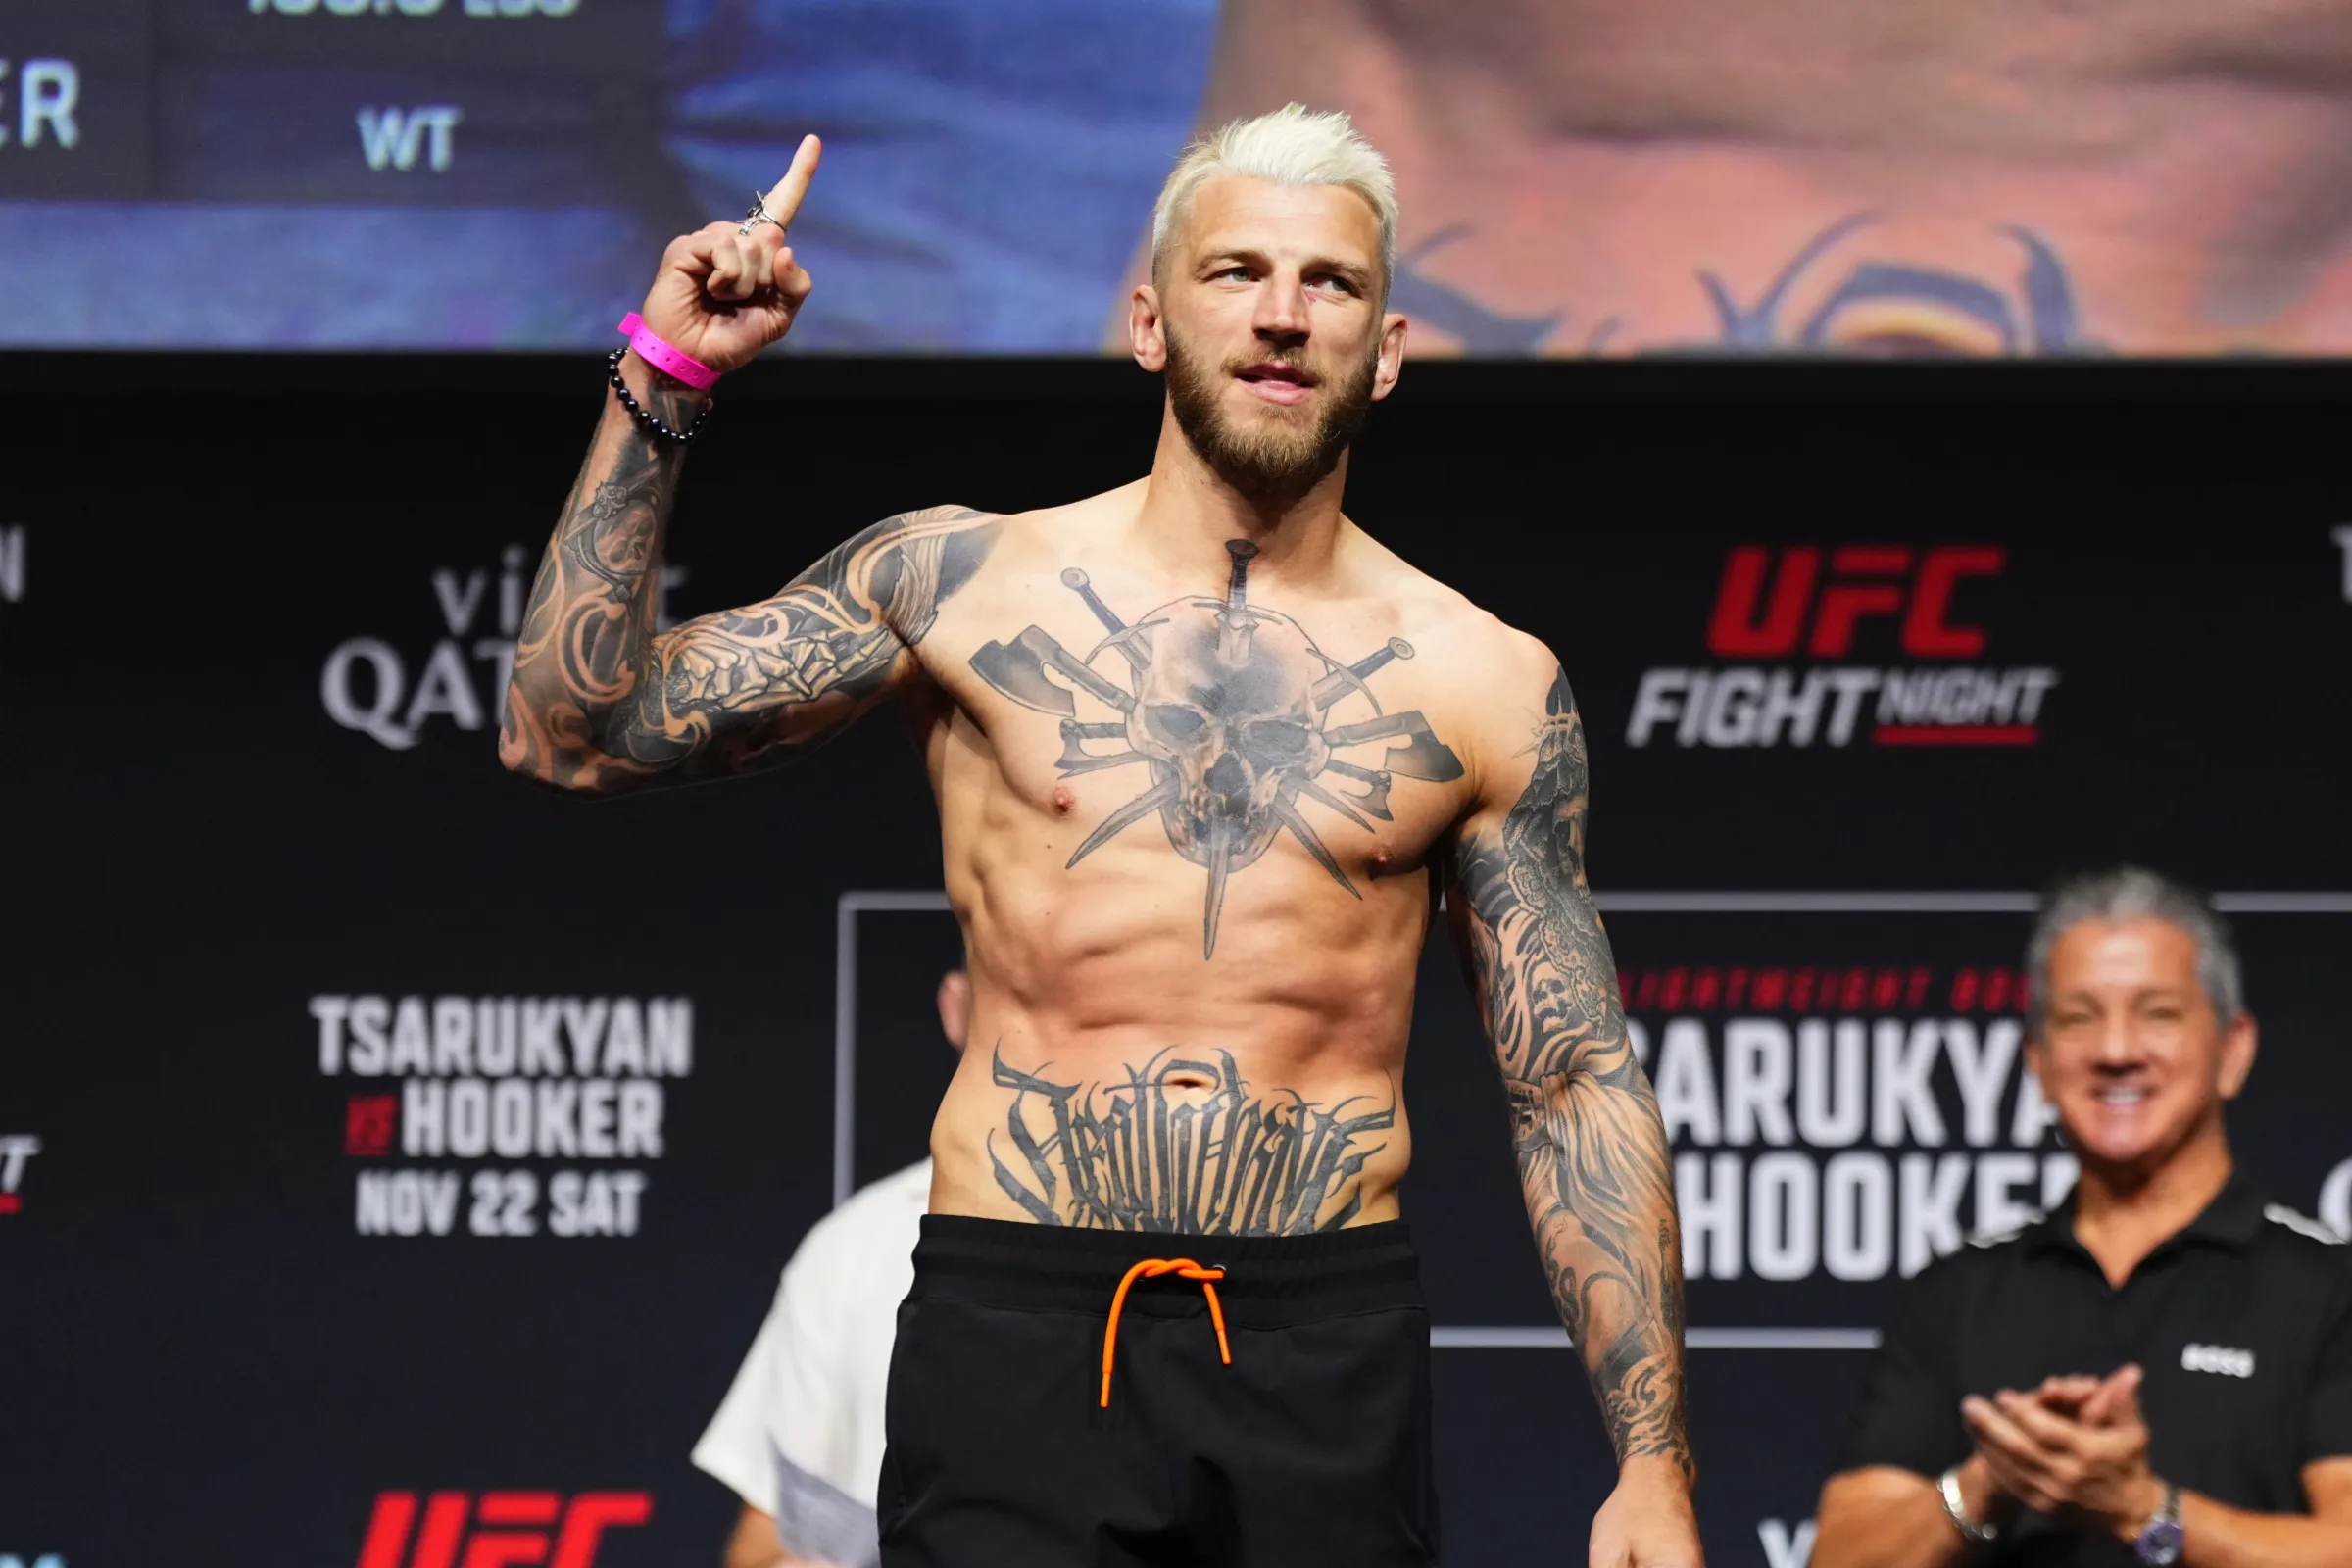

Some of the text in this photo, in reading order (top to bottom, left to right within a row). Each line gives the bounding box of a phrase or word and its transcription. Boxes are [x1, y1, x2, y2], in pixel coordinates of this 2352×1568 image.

[356, 105, 462, 172] WT
[1707, 546, 2005, 658] UFC
[1626, 668, 2056, 748] FIGHT NIGHT
[309, 995, 694, 1077] TSARUKYAN
[401, 1078, 664, 1157] HOOKER
[355, 1169, 648, 1238] NOV 22 SAT
